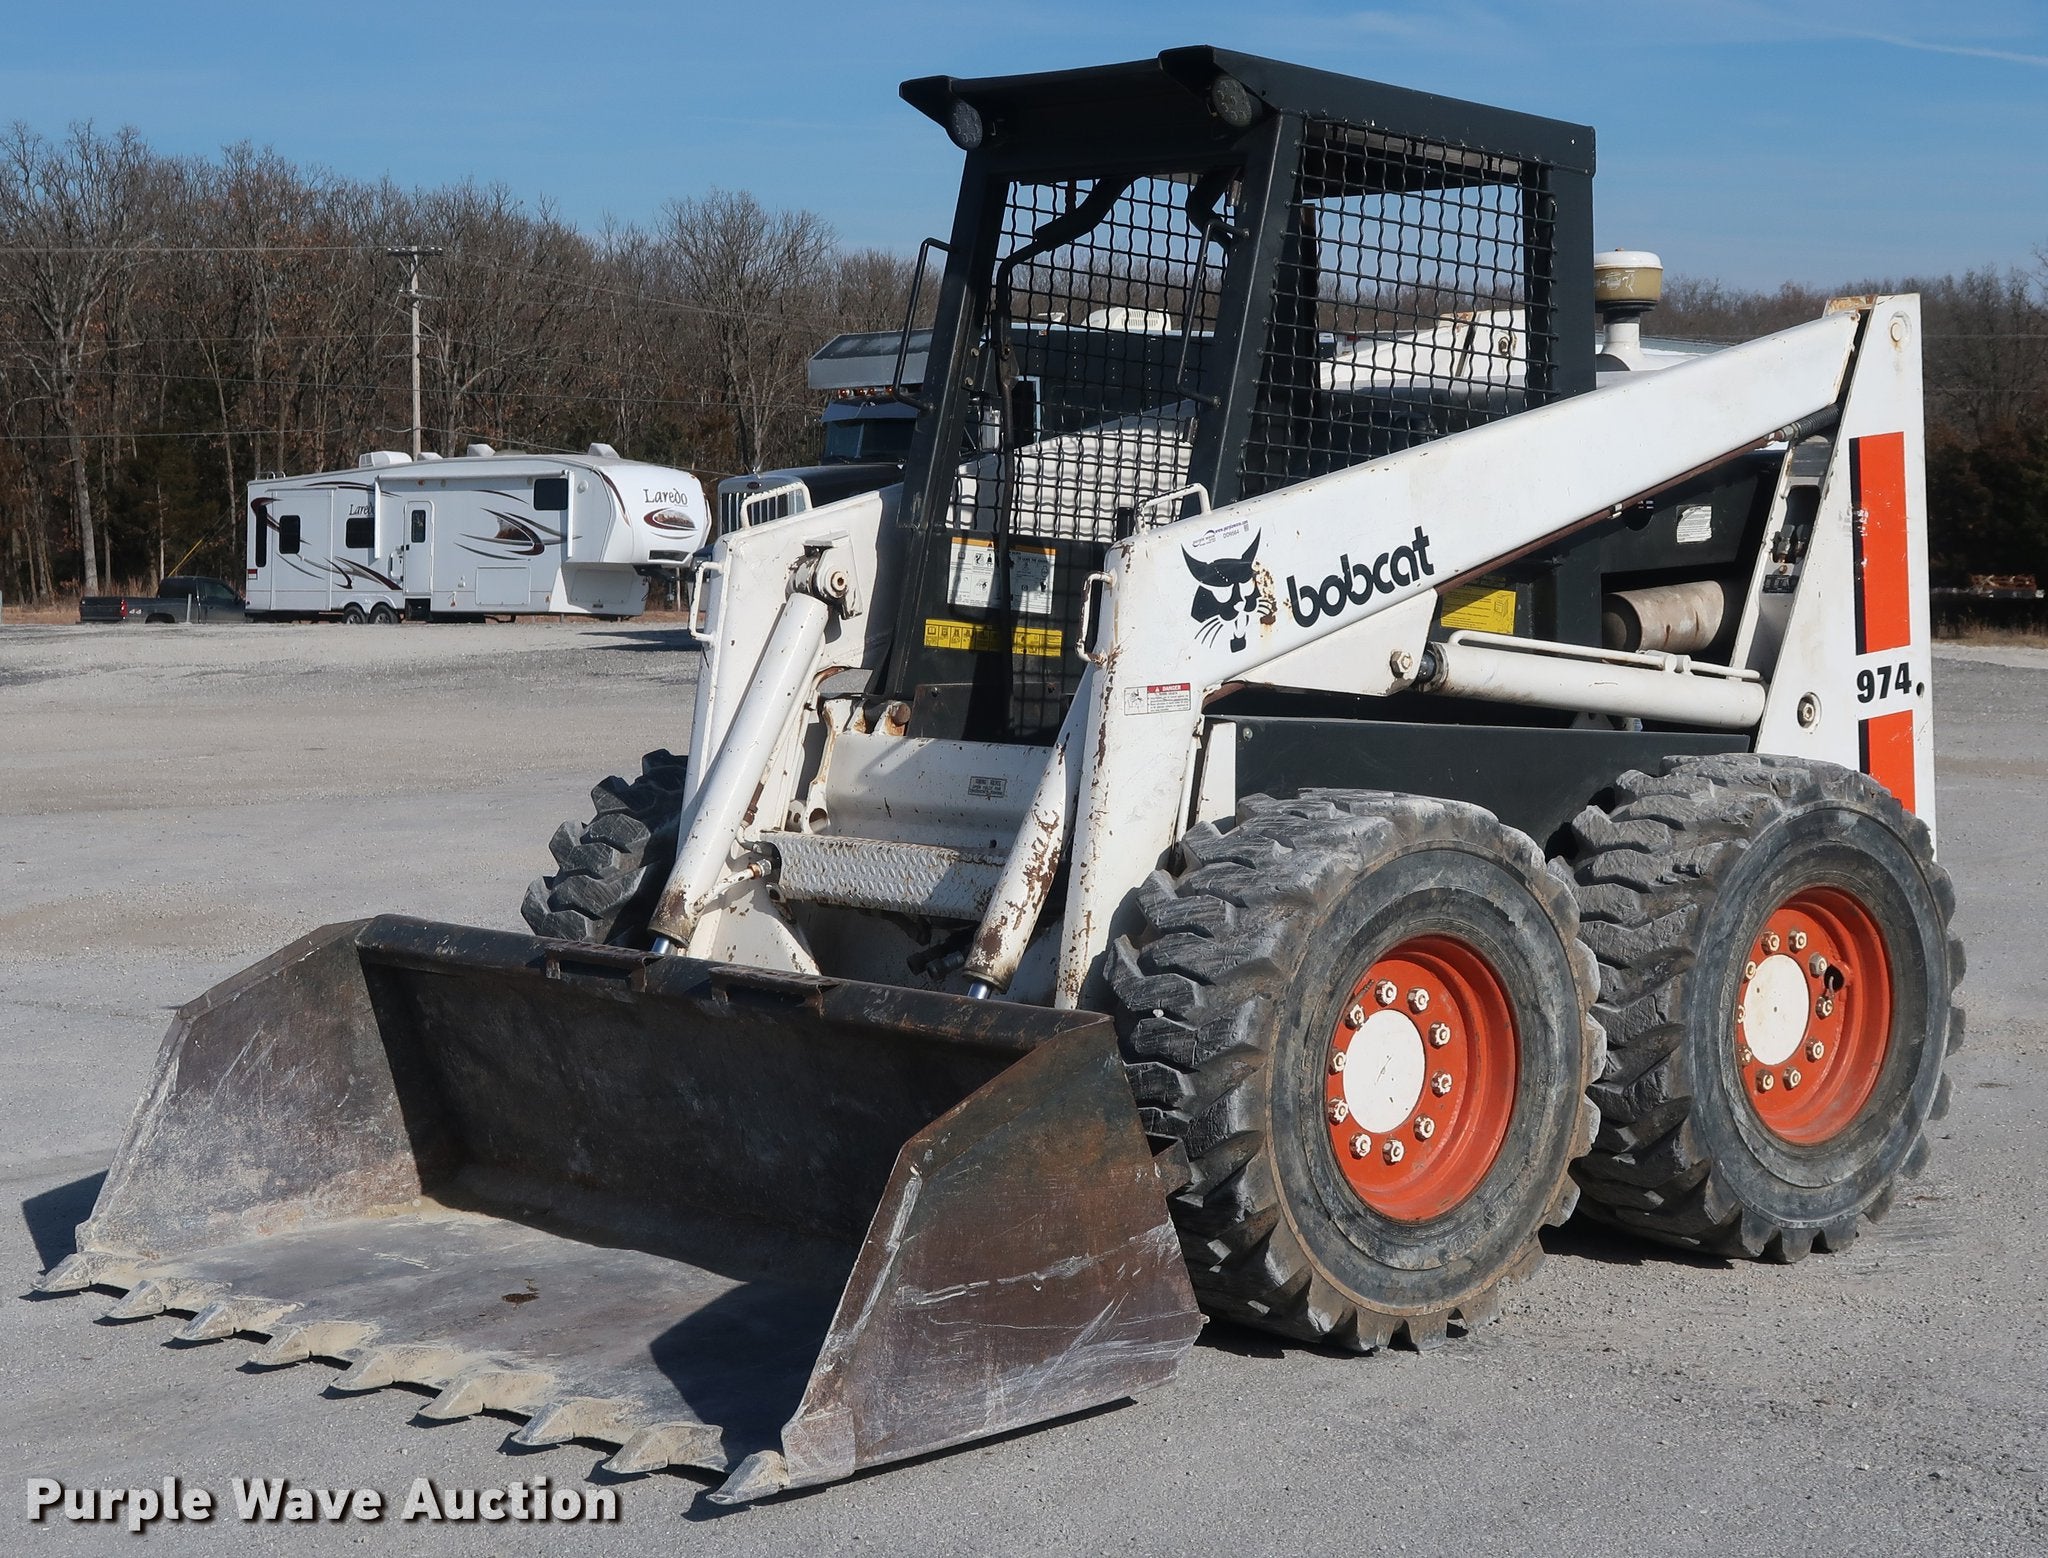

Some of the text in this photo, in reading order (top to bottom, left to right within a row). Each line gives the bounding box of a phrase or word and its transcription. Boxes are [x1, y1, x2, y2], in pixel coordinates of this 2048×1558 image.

[349, 502, 375, 516] Lared
[643, 488, 688, 506] Laredo
[1286, 526, 1434, 628] bobcat
[1857, 662, 1912, 704] 974
